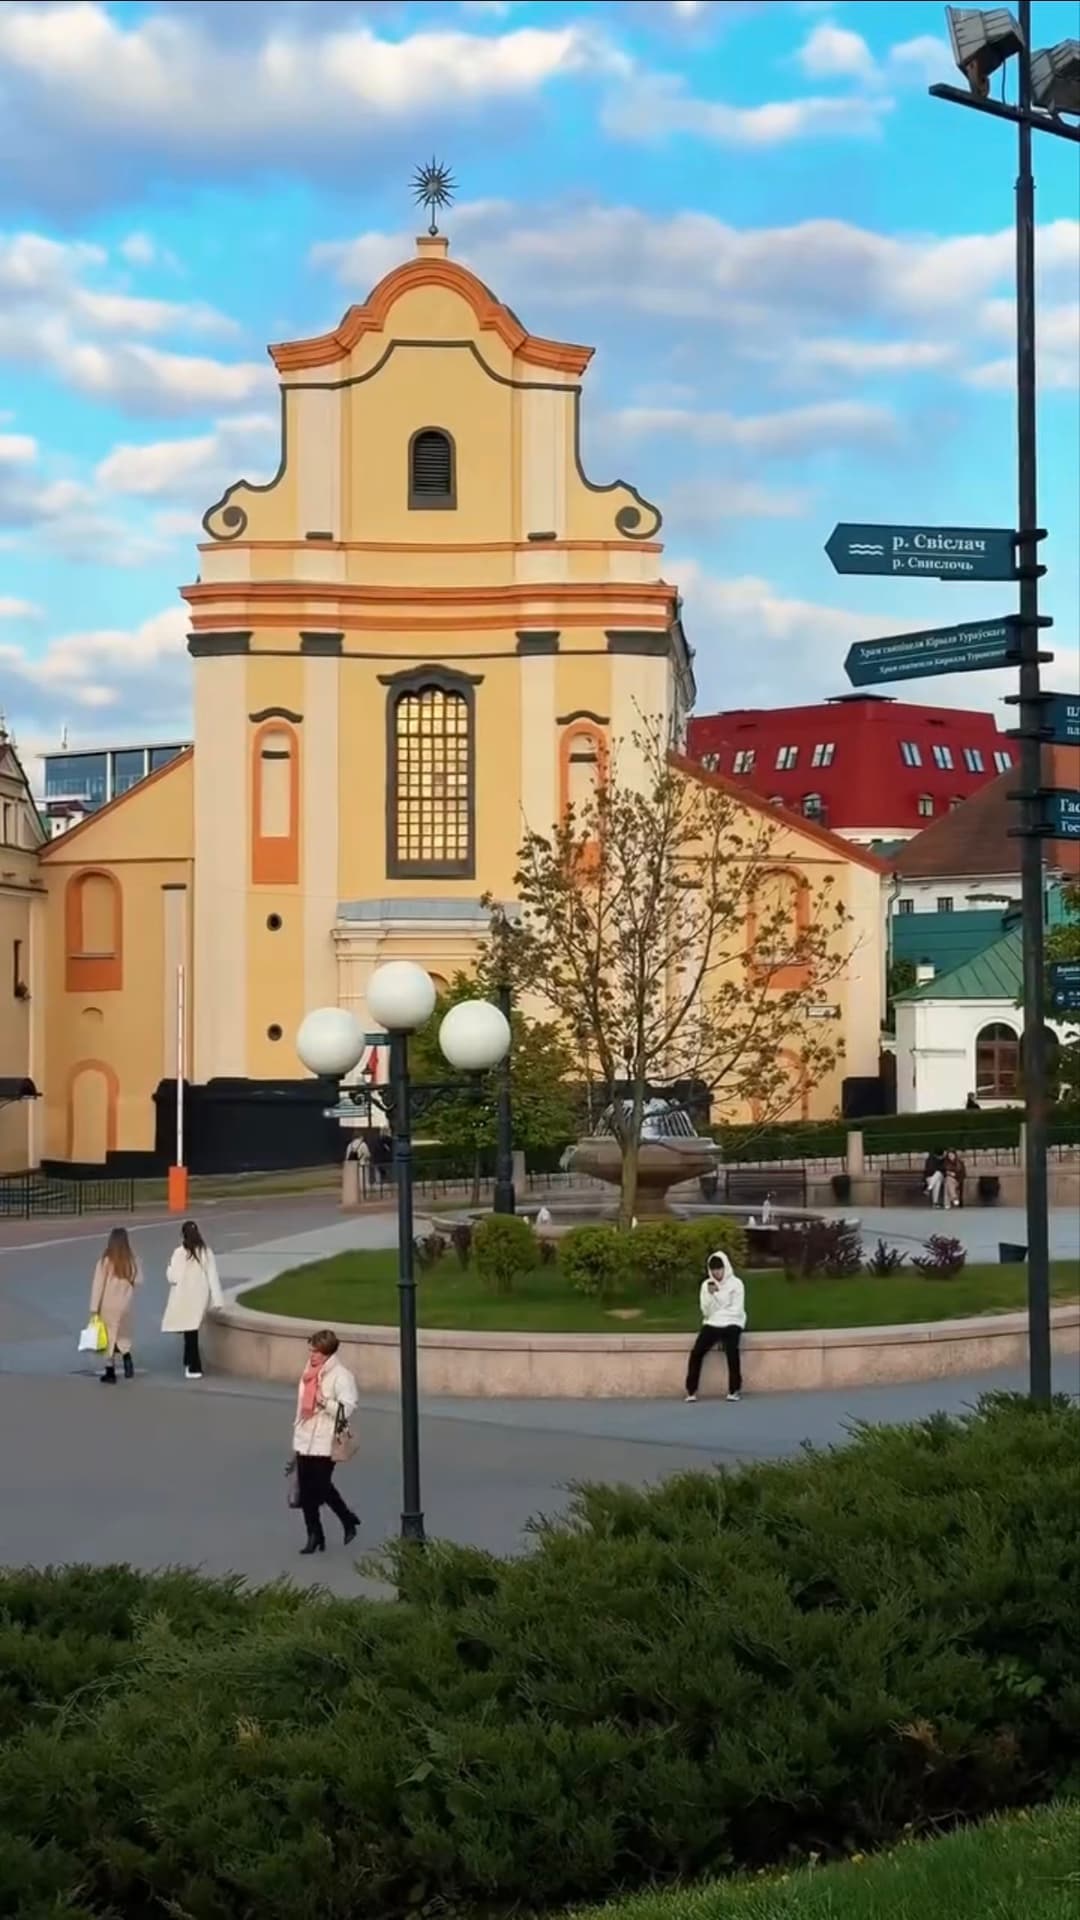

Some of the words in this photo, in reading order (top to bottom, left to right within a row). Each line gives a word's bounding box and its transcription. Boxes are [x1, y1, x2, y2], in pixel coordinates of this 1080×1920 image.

[892, 535, 909, 551] р.
[914, 533, 987, 551] Свіслач
[892, 558, 905, 571] р.
[908, 556, 974, 571] Свислочь
